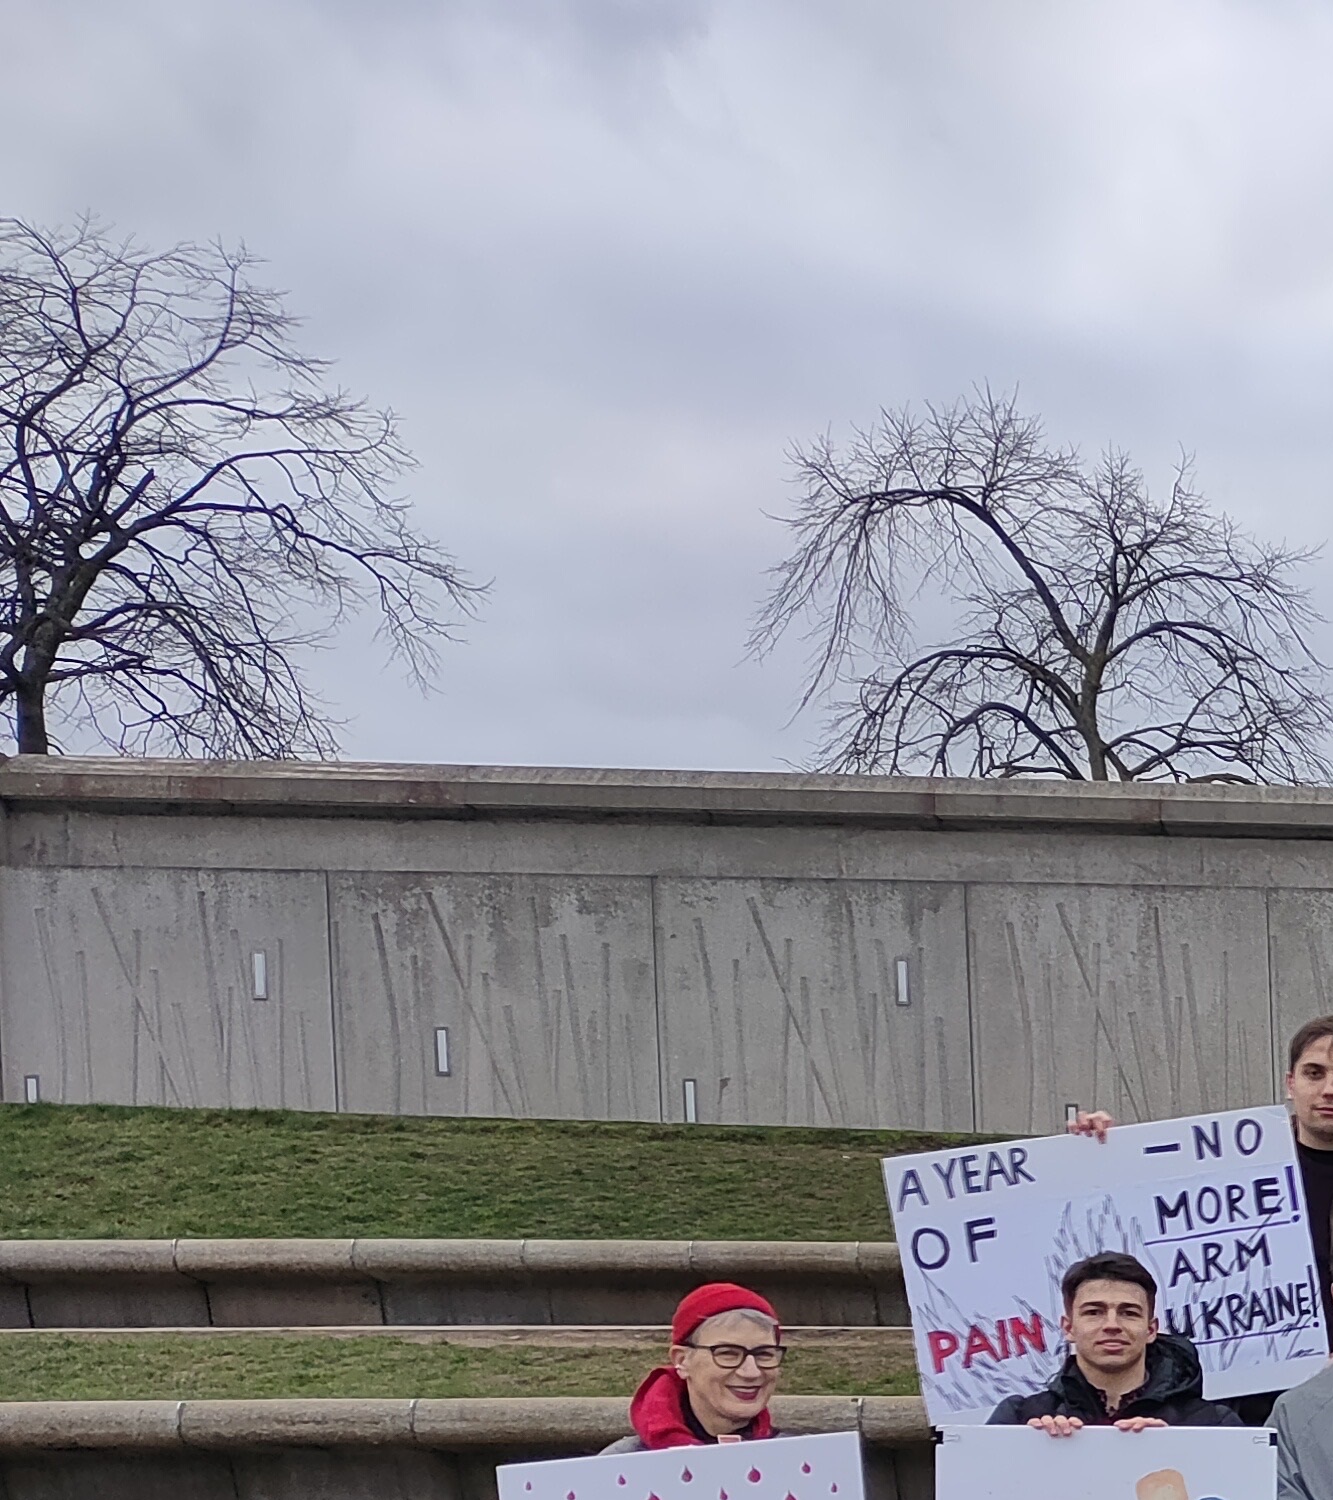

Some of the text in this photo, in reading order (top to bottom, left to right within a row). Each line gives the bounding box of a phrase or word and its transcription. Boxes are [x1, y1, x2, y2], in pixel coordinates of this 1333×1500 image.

[898, 1147, 1036, 1212] A YEAR
[1153, 1165, 1301, 1236] MORE!
[911, 1217, 998, 1270] OF
[1169, 1233, 1270, 1288] ARM
[1165, 1264, 1320, 1340] UKRAINE!
[928, 1313, 1046, 1374] PAIN
